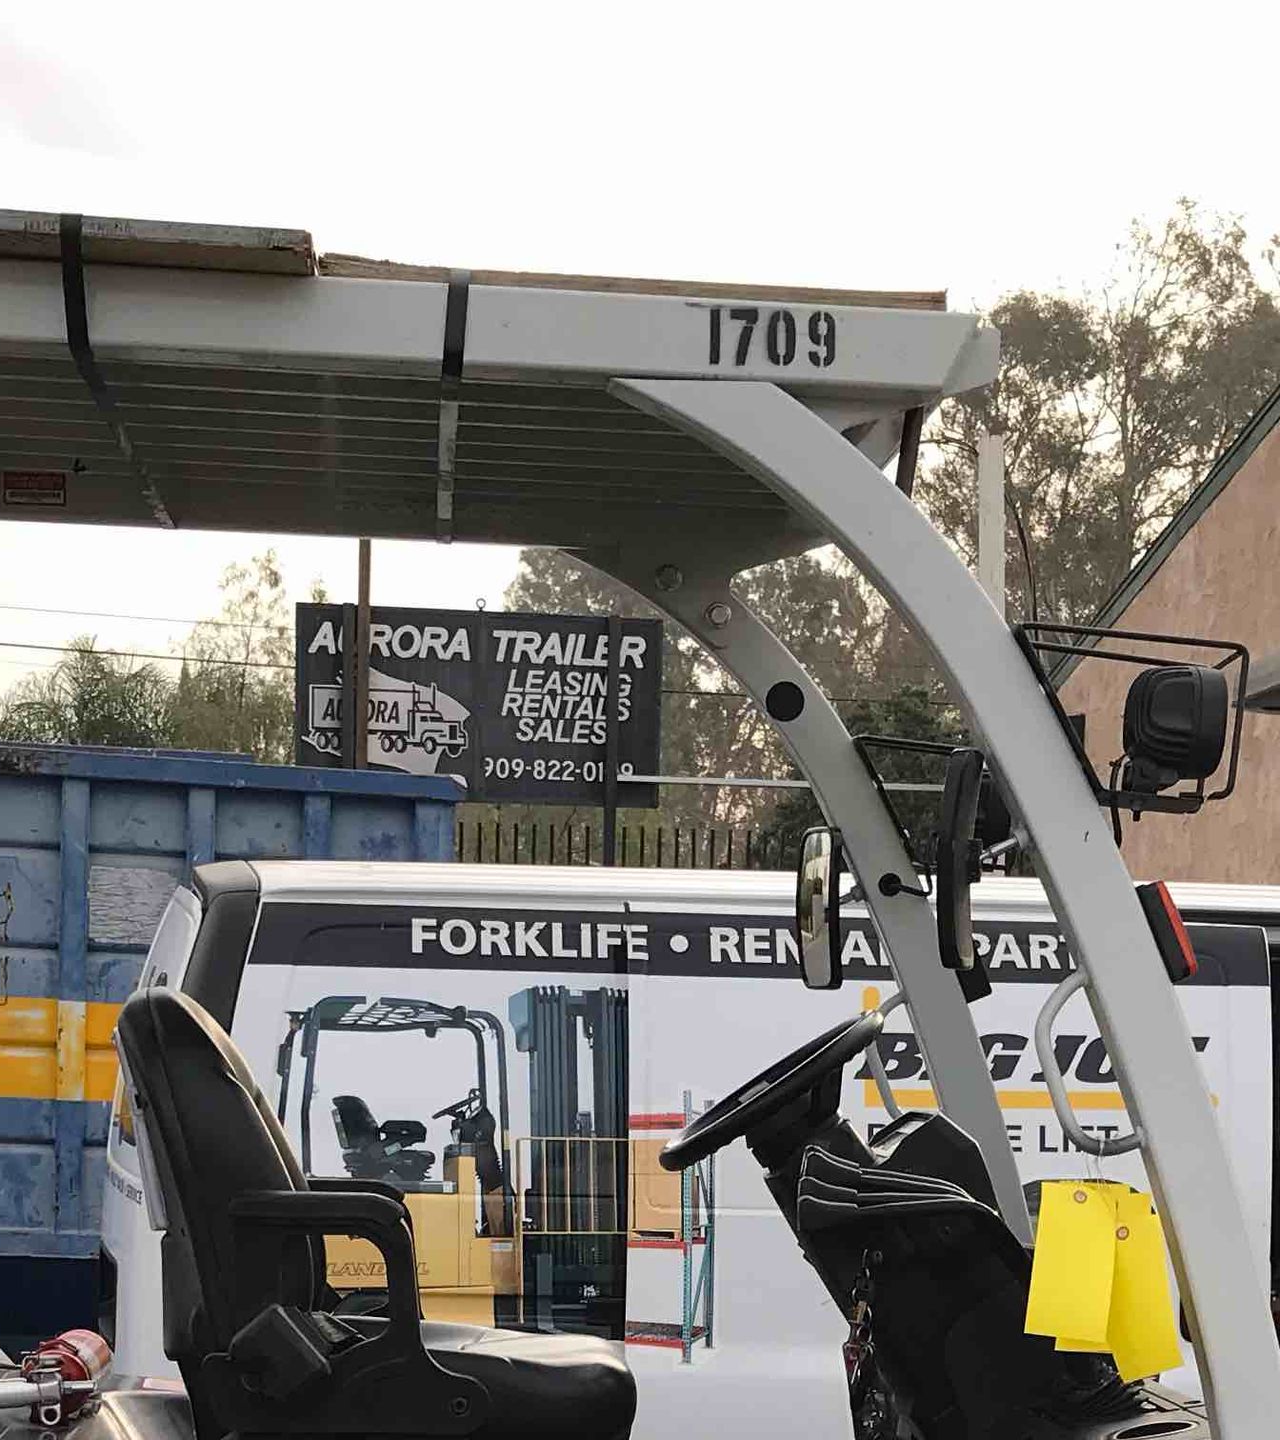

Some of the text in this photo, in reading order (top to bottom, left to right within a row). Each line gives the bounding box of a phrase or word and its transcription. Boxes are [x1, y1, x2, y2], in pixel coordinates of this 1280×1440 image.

[709, 308, 836, 367] 1709
[492, 629, 647, 669] TRAILER
[507, 668, 632, 699] LEASING
[322, 698, 400, 724] AORA
[501, 692, 632, 722] RENTALS
[515, 720, 607, 746] SALES
[484, 755, 634, 783] 909-822-019
[854, 1032, 1210, 1084] BG JO
